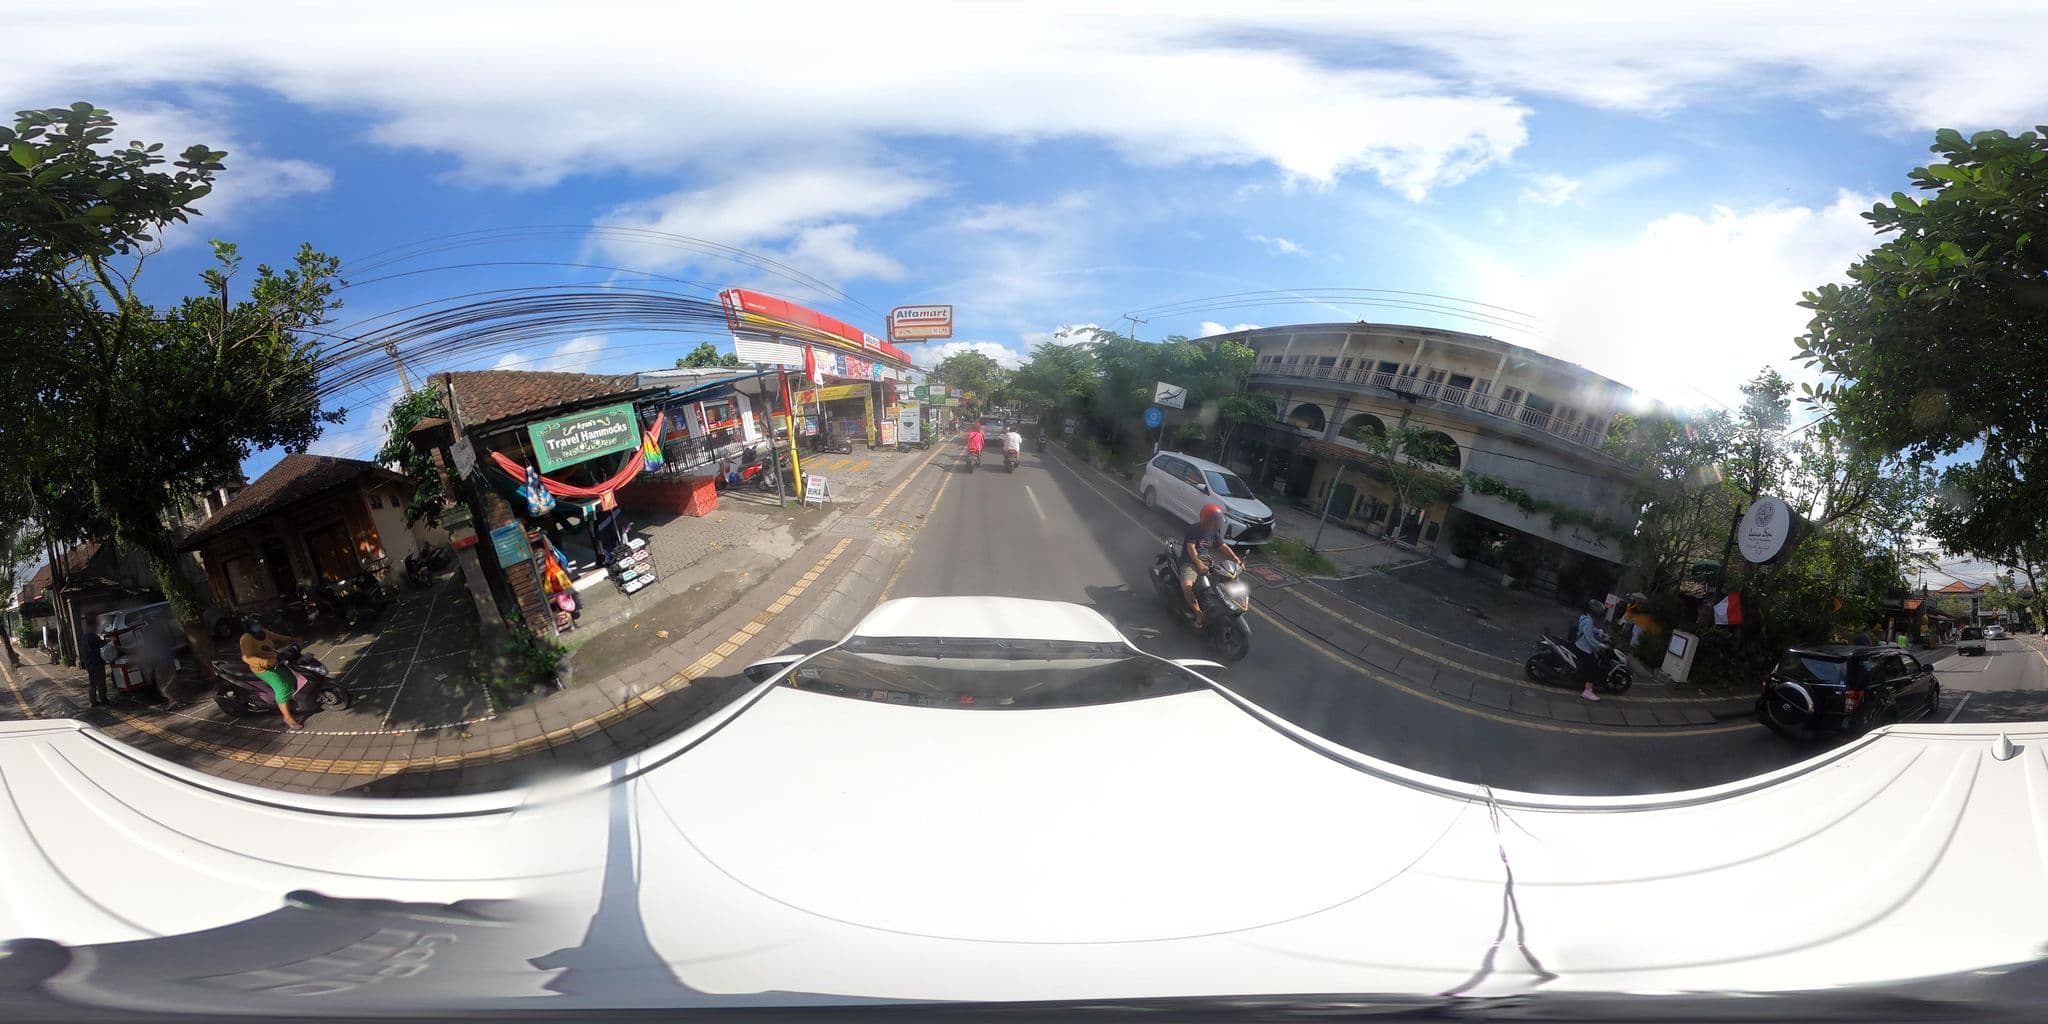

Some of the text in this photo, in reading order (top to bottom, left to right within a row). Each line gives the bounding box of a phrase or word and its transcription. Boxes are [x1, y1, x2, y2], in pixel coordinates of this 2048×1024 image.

[896, 309, 948, 319] Alfamart
[546, 422, 628, 450] Travel Hammocks
